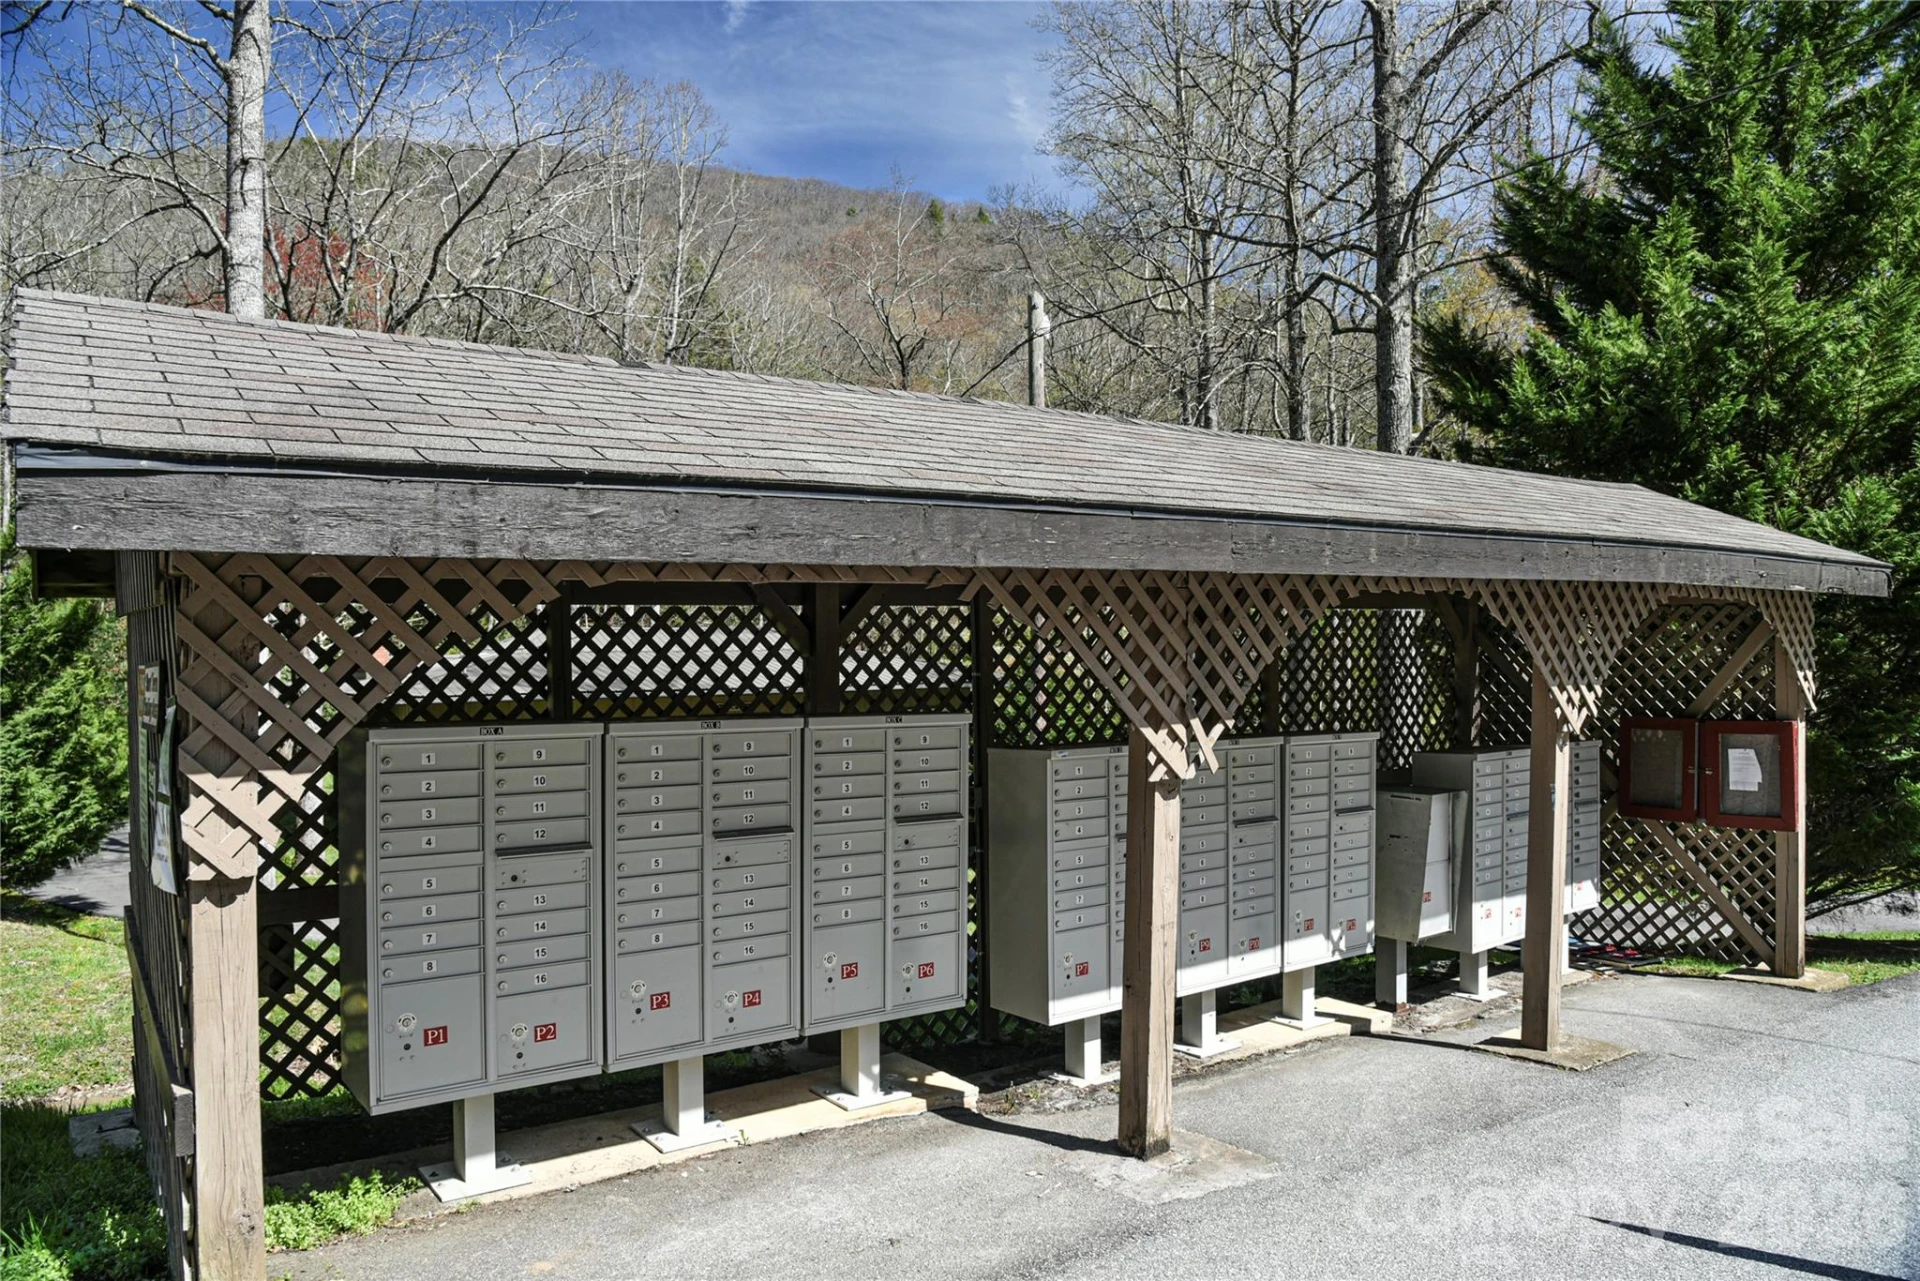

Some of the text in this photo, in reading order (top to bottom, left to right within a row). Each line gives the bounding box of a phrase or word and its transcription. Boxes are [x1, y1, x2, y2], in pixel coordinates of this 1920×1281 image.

[922, 736, 928, 744] 9
[746, 742, 752, 751] 9
[426, 754, 431, 763] 1
[536, 750, 542, 759] 9
[744, 766, 754, 774] 10
[845, 762, 850, 770] 2
[654, 771, 660, 780] 2
[534, 776, 546, 785] 10
[425, 782, 432, 791] 2
[845, 784, 850, 793] 3
[744, 790, 753, 798] 11
[654, 796, 660, 805] 3
[534, 803, 544, 812] 11
[426, 809, 432, 819] 3
[744, 814, 754, 823] 12
[654, 822, 660, 830] 4
[534, 829, 546, 838] 12
[425, 838, 432, 847] 4
[654, 858, 660, 868] 5
[426, 878, 433, 888] 5
[744, 874, 754, 883] 13
[654, 884, 660, 893] 6
[534, 895, 546, 904] 13
[744, 898, 754, 907] 14
[426, 906, 433, 916] 6
[654, 909, 660, 918] 7
[844, 910, 849, 918] 8
[535, 922, 546, 931] 14
[744, 922, 754, 930] 15
[426, 934, 432, 943] 7
[654, 934, 660, 943] 8
[535, 948, 547, 957] 15
[744, 946, 754, 954] 16
[426, 962, 434, 971] 8
[842, 964, 857, 978] P5
[920, 964, 934, 977] P6
[1076, 964, 1088, 976] P7
[535, 974, 547, 984] 16
[652, 994, 669, 1009] P3
[744, 992, 760, 1006] P4
[426, 1028, 445, 1044] P1
[536, 1025, 555, 1041] P2
